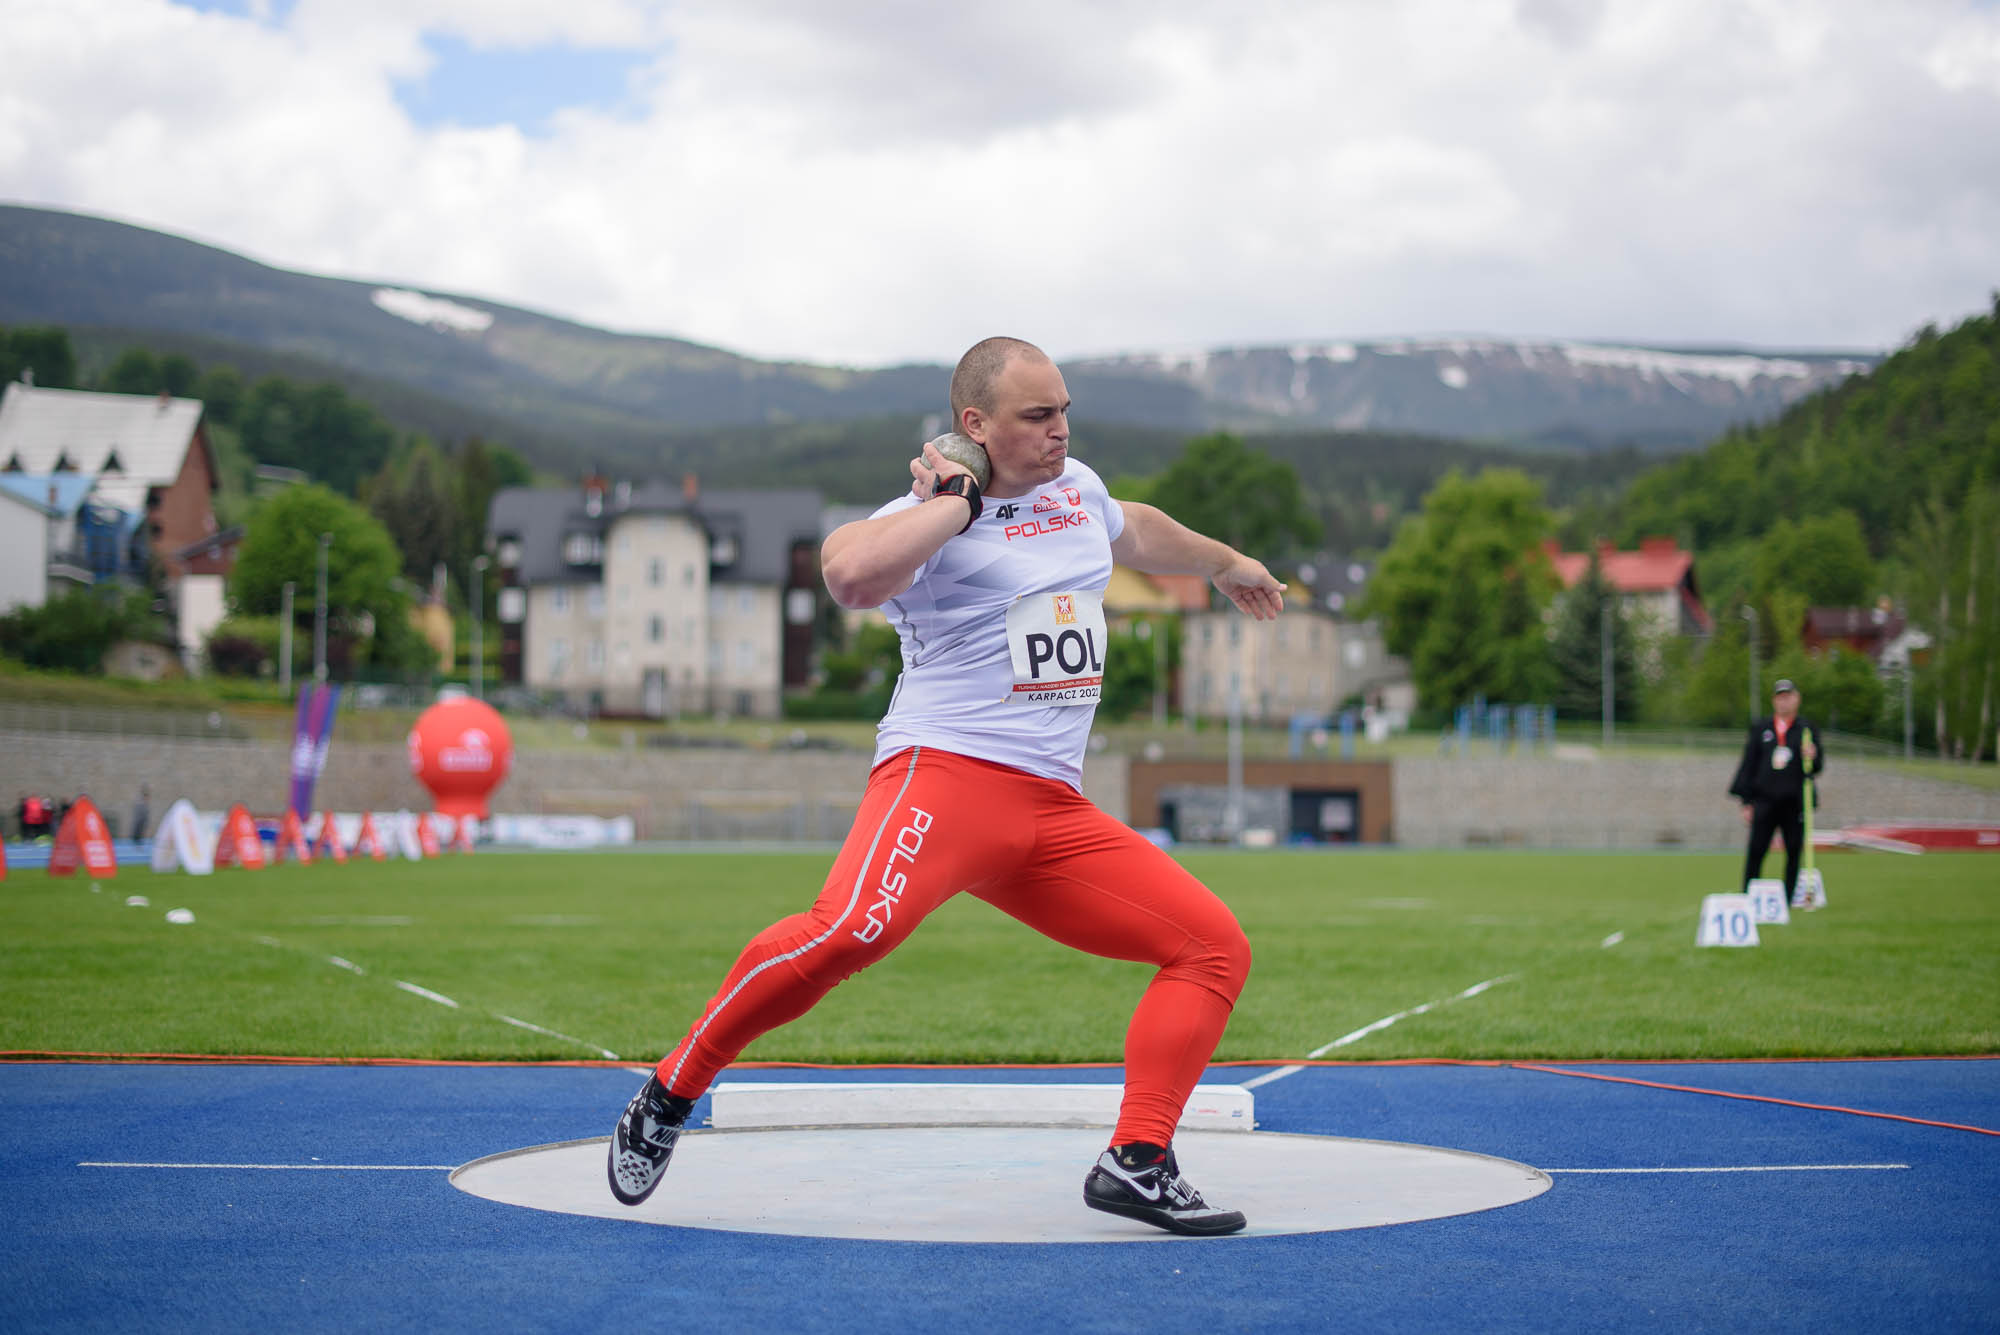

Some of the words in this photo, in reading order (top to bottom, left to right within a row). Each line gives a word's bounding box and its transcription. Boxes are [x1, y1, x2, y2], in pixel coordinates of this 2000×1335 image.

[1004, 511, 1089, 541] POLSKA
[1025, 628, 1101, 679] POL
[1028, 690, 1076, 701] KARPACZ
[852, 807, 933, 944] POLSKA
[1712, 911, 1749, 942] 10
[649, 1126, 678, 1147] NIK
